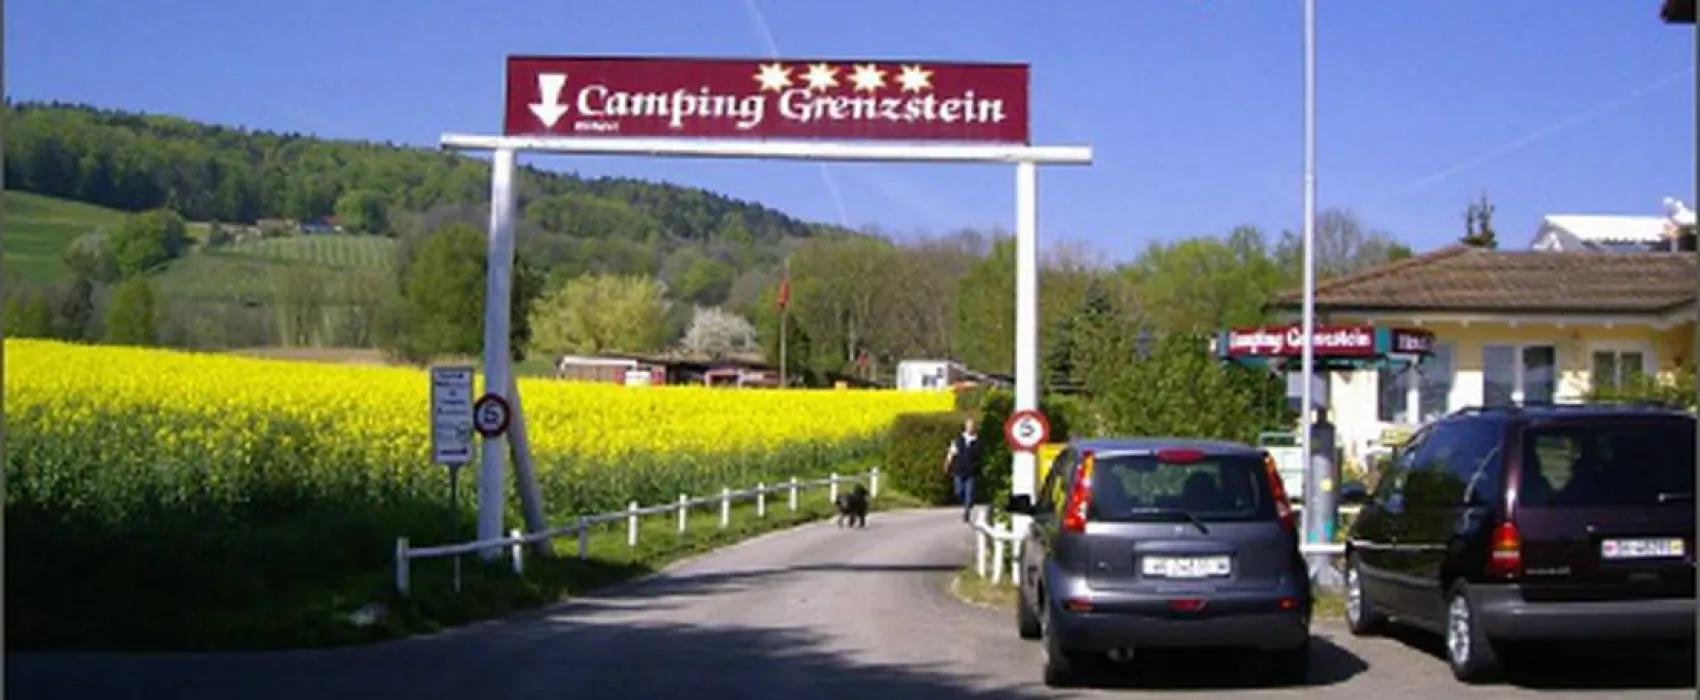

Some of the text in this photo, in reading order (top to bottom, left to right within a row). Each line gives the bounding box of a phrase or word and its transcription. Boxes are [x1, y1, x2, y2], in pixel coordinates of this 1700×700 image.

[576, 84, 1007, 129] Camping Grenzstein
[1287, 327, 1372, 348] Gnzstein
